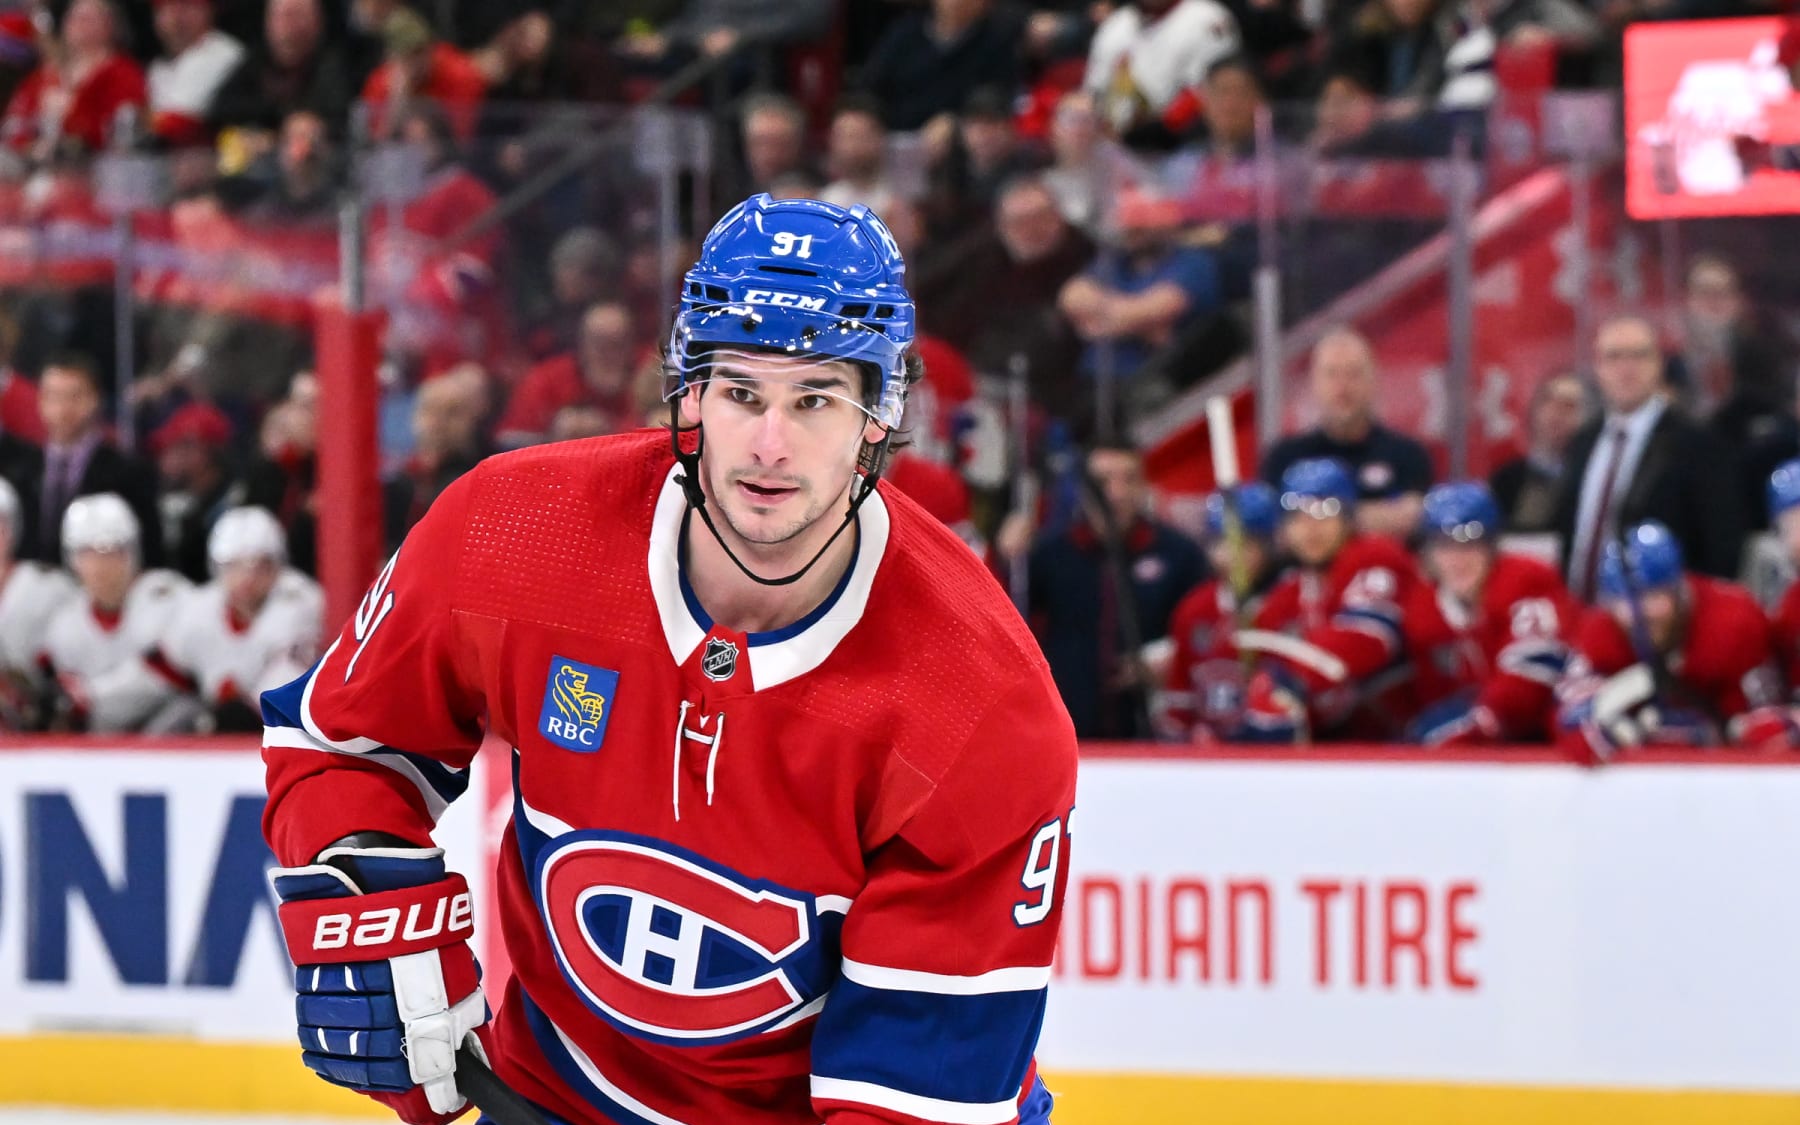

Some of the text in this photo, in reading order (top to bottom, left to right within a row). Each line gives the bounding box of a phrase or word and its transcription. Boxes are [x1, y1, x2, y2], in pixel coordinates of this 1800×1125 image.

[771, 231, 812, 259] 91
[744, 289, 827, 310] CCM
[547, 716, 595, 745] RBC
[0, 791, 294, 986] NA
[313, 891, 474, 951] BAUE
[1055, 879, 1479, 990] DIAN TIRE
